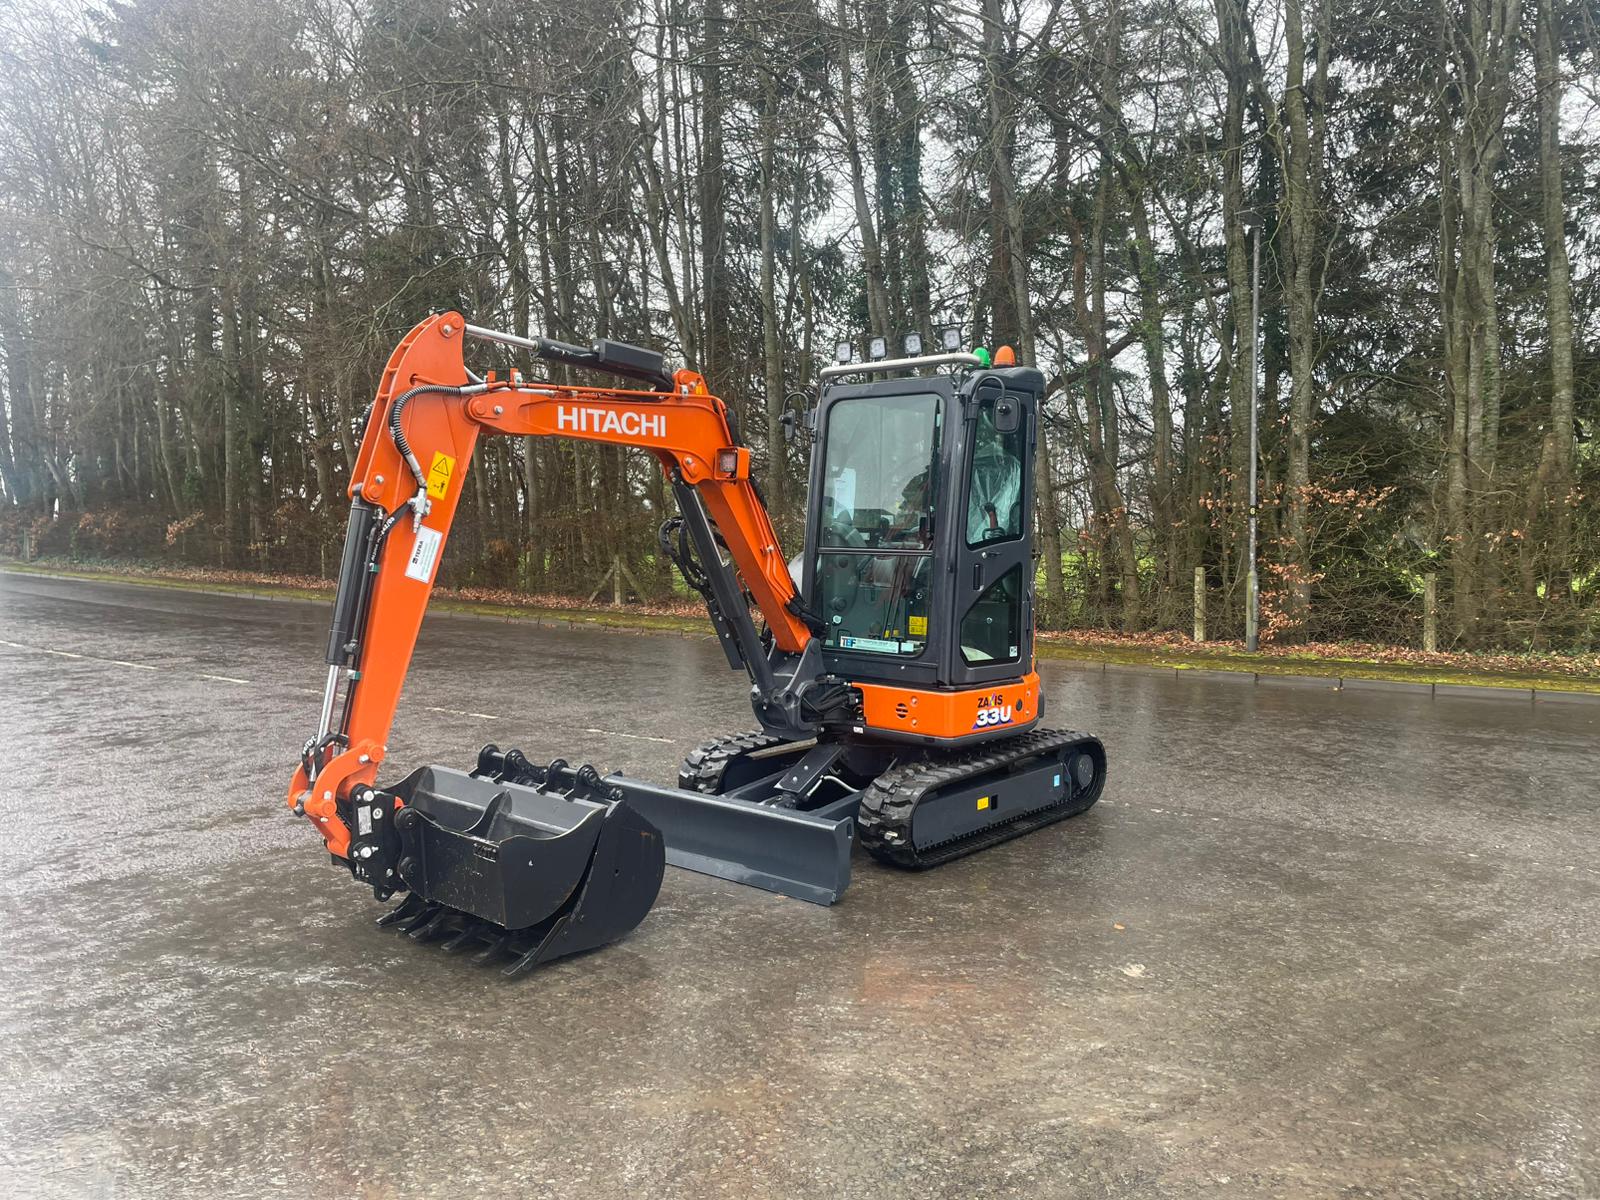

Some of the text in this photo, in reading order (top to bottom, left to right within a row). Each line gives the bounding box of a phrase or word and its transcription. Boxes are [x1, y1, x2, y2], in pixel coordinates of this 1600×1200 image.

[557, 405, 666, 437] HITACHI
[977, 693, 1003, 708] ZAXIS
[975, 704, 1012, 727] 33U
